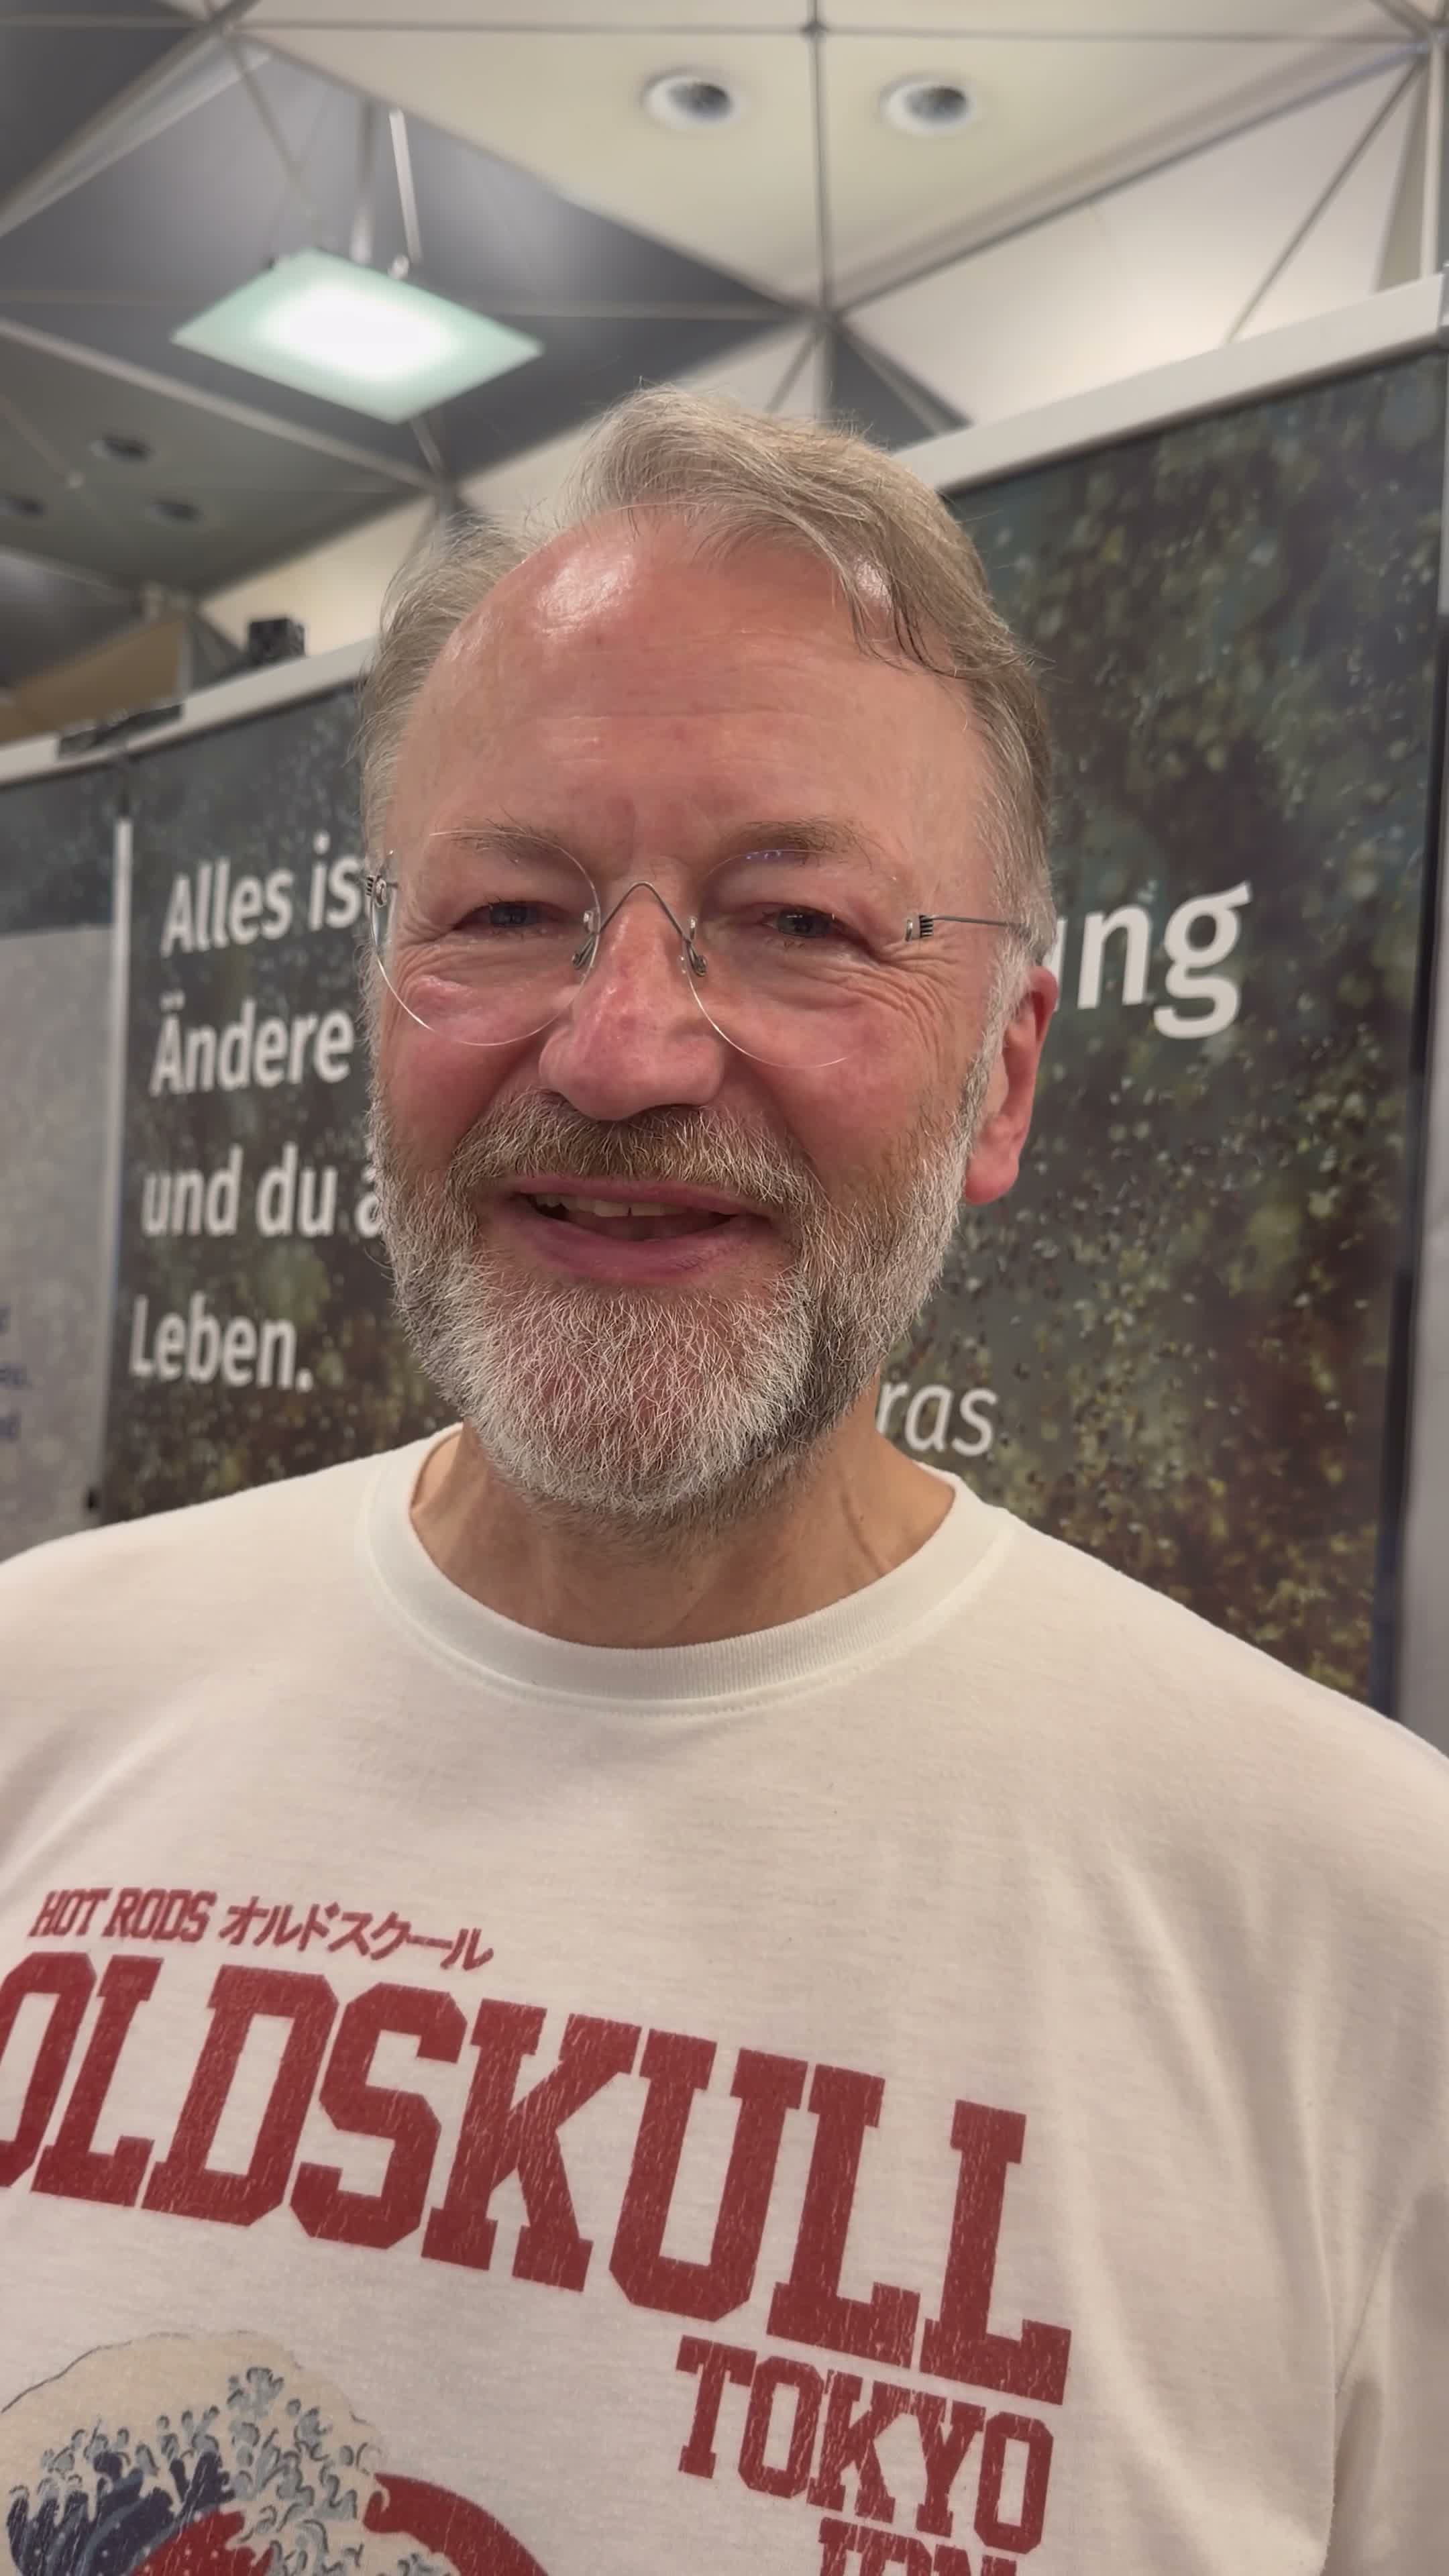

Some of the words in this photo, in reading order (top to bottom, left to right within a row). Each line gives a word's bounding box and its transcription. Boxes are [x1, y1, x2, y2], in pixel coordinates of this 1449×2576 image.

[160, 858, 292, 958] Alles
[150, 990, 354, 1096] Ändere
[141, 1144, 242, 1237] und
[256, 1141, 337, 1237] du
[129, 1293, 314, 1393] Leben.
[28, 1887, 113, 1937] HOT
[101, 1887, 217, 1943] RODS
[218, 1896, 495, 1971] オルドスクール
[0, 1951, 1071, 2406] OLDSKULL
[675, 2334, 1054, 2555] TOKYO
